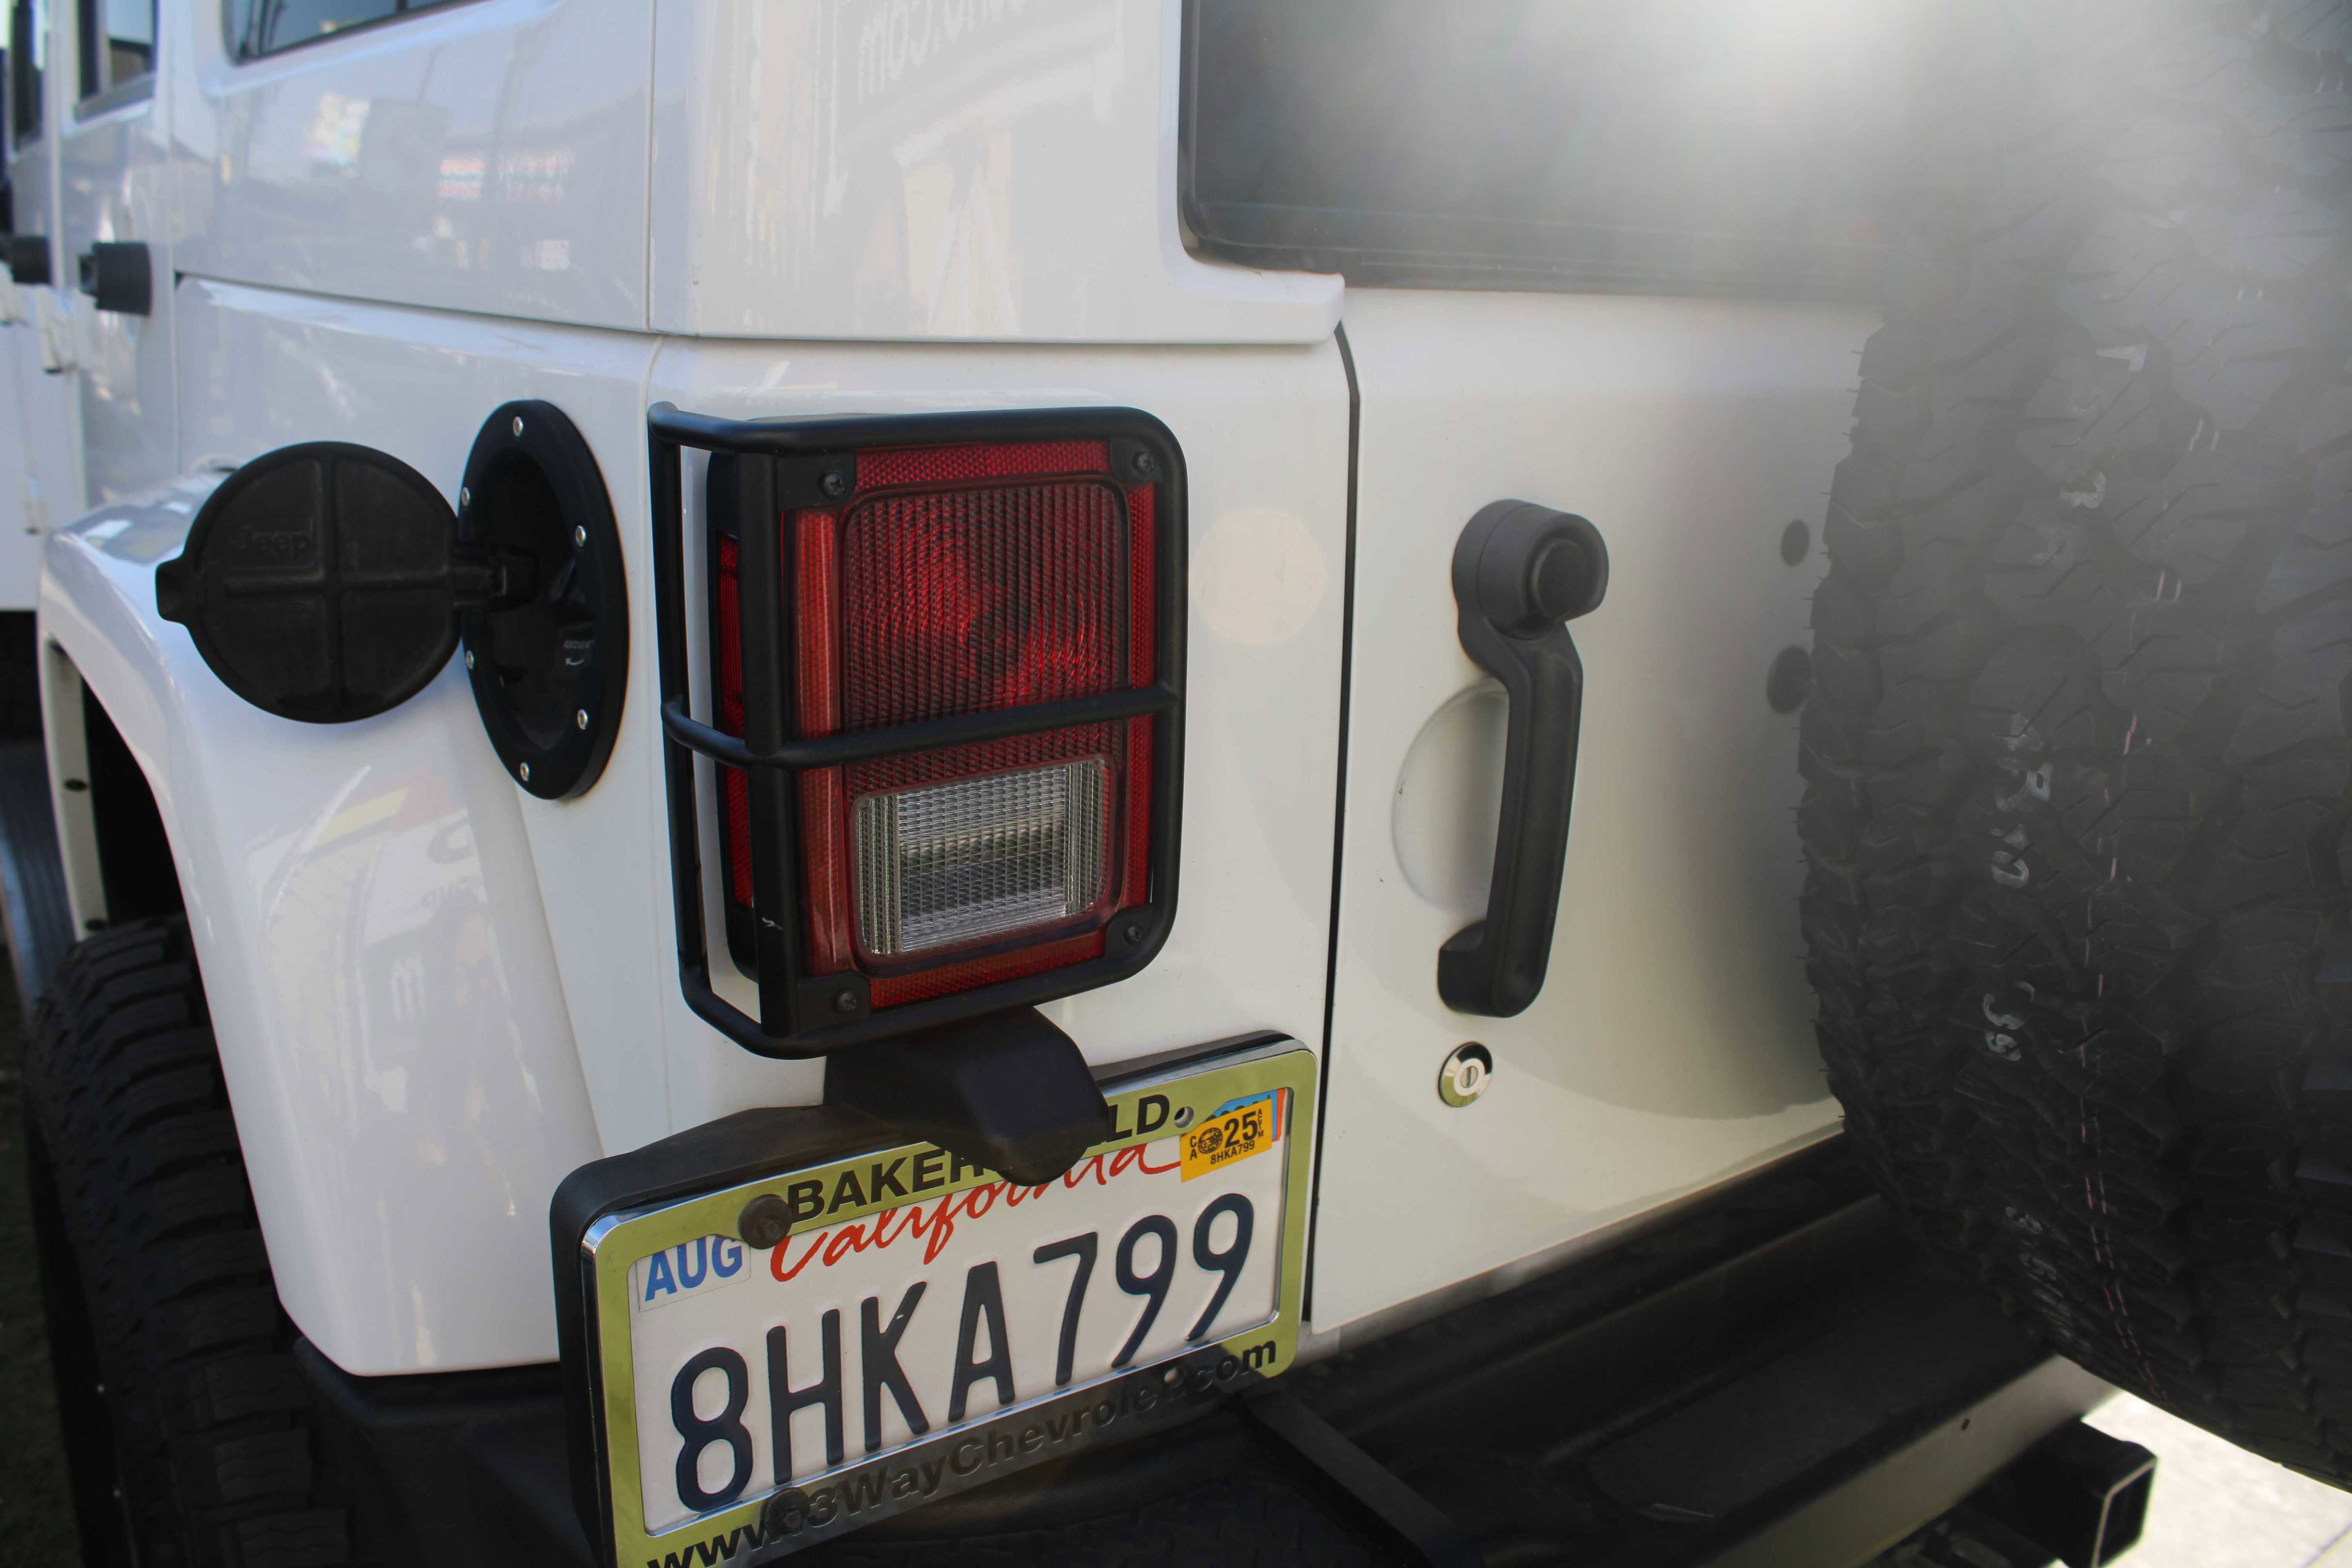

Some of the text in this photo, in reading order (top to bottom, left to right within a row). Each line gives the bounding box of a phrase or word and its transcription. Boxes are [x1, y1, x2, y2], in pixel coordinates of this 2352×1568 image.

[787, 1094, 1170, 1222] BAKERLD
[1210, 1140, 1255, 1165] 8HKA799
[1224, 1111, 1258, 1149] 25
[645, 1236, 743, 1302] AUG
[671, 1192, 1254, 1512] 8HKA799
[647, 1340, 1276, 1568] www3WayChevrole.com
